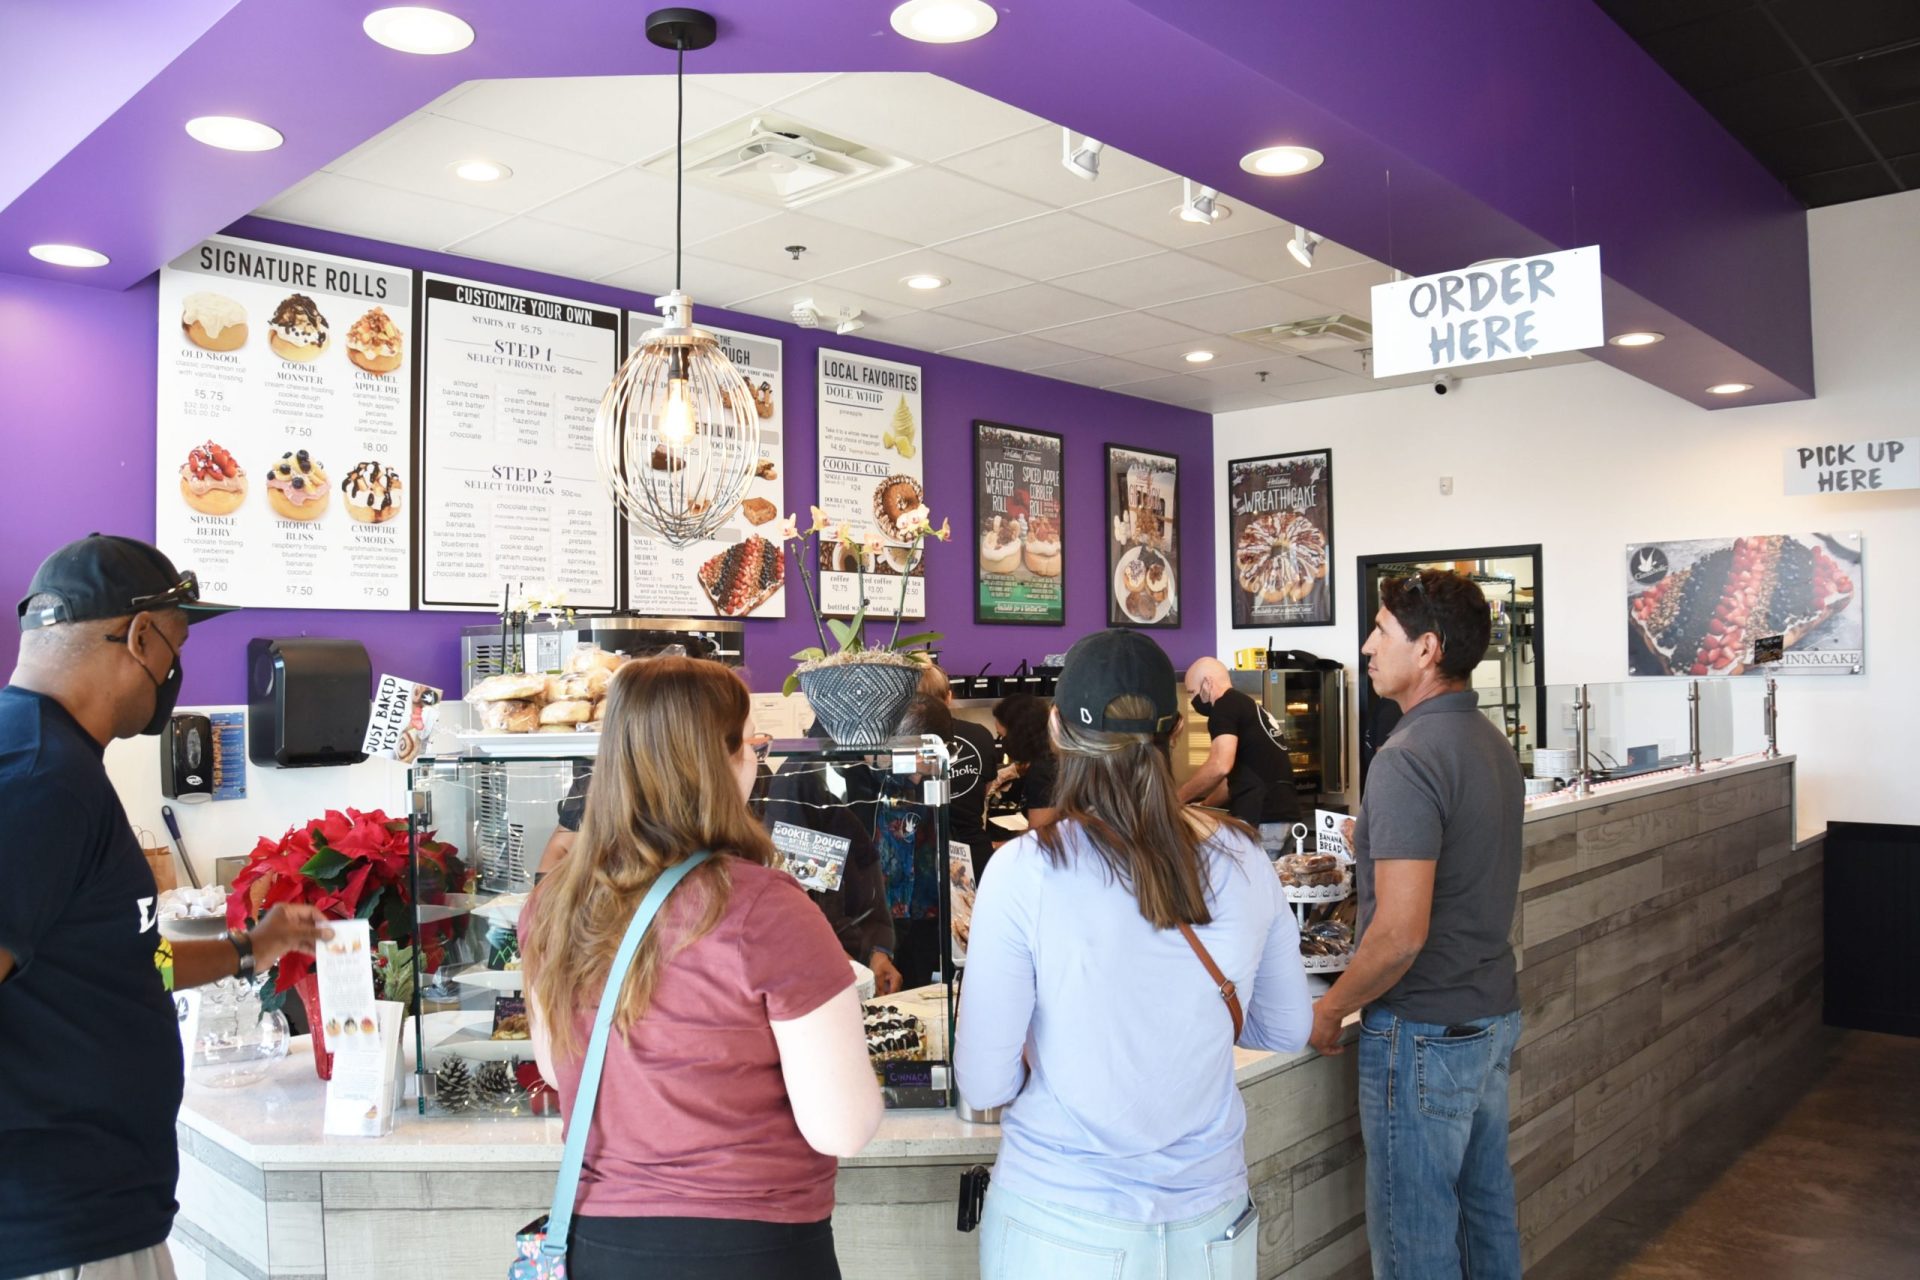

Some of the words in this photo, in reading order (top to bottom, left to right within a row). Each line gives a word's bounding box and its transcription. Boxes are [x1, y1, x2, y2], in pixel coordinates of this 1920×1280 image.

[200, 246, 317, 288] SIGNATURE
[326, 267, 388, 299] ROLLS
[1409, 260, 1555, 318] ORDER
[456, 286, 527, 314] CUSTOMIZE
[530, 300, 562, 321] YOUR
[566, 307, 593, 326] OWN
[472, 315, 503, 328] STARTS
[505, 319, 516, 330] AT
[720, 335, 731, 347] THE
[1429, 310, 1539, 365] HERE
[182, 350, 203, 359] OLD
[206, 352, 241, 364] SKOOL
[494, 339, 541, 360] STEP
[546, 347, 553, 362] 1
[721, 347, 751, 366] OUGH
[282, 361, 318, 374] COOKIE
[467, 351, 504, 367] SELECT
[508, 356, 557, 374] FROSTING
[277, 371, 324, 385] MONSTER
[354, 371, 399, 385] CARAMEL
[824, 359, 858, 382] LOCAL
[863, 366, 918, 392] FAVORITES
[354, 382, 380, 394] APPLE
[384, 385, 400, 396] PIE
[453, 379, 479, 390] almond
[194, 388, 224, 401] $5.75
[442, 388, 468, 398] banana
[469, 391, 490, 401] cream
[826, 385, 854, 400] DOLE
[856, 391, 883, 404] WHIP
[285, 425, 312, 437] $7.50
[450, 430, 482, 440] chocolate
[363, 441, 388, 453] $8.00
[1797, 444, 1856, 469] PICK
[1867, 441, 1904, 464] UP
[823, 457, 862, 473] COOKIE
[865, 463, 891, 477] CAKE
[985, 460, 1015, 480] SWEATER
[492, 464, 539, 484] STEP
[543, 469, 553, 485] 2
[1043, 469, 1060, 487] APPLE
[1817, 468, 1883, 492] HERE
[464, 479, 503, 493] SELECT
[506, 482, 555, 497] TOPPINGS
[985, 477, 1015, 497] WEATHER
[992, 495, 1008, 513] ROLL
[1243, 488, 1288, 512] WREATH
[1291, 484, 1317, 509] CAKE
[444, 500, 475, 511] almonds
[190, 515, 238, 526] SPARKLE
[276, 520, 323, 531] TROPICAL
[197, 527, 231, 537] BERRY
[351, 524, 398, 535] CAMPFIRE
[286, 532, 315, 542] BLISS
[355, 536, 396, 546] S'MORES
[432, 569, 466, 579] chocolate
[830, 575, 849, 584] coffee
[874, 577, 892, 587] coffee
[286, 585, 313, 596] $7.50
[363, 586, 389, 597] $7.50
[366, 724, 383, 753] JUST
[376, 677, 397, 718] BAKED
[382, 686, 409, 751] YESTERDAY
[948, 764, 979, 779] holic
[774, 824, 810, 842] COOKIE
[813, 834, 849, 851] DOUGH
[1319, 832, 1343, 845] BANANA
[1320, 841, 1343, 854] BREAD
[890, 1072, 931, 1082] CINNACA
